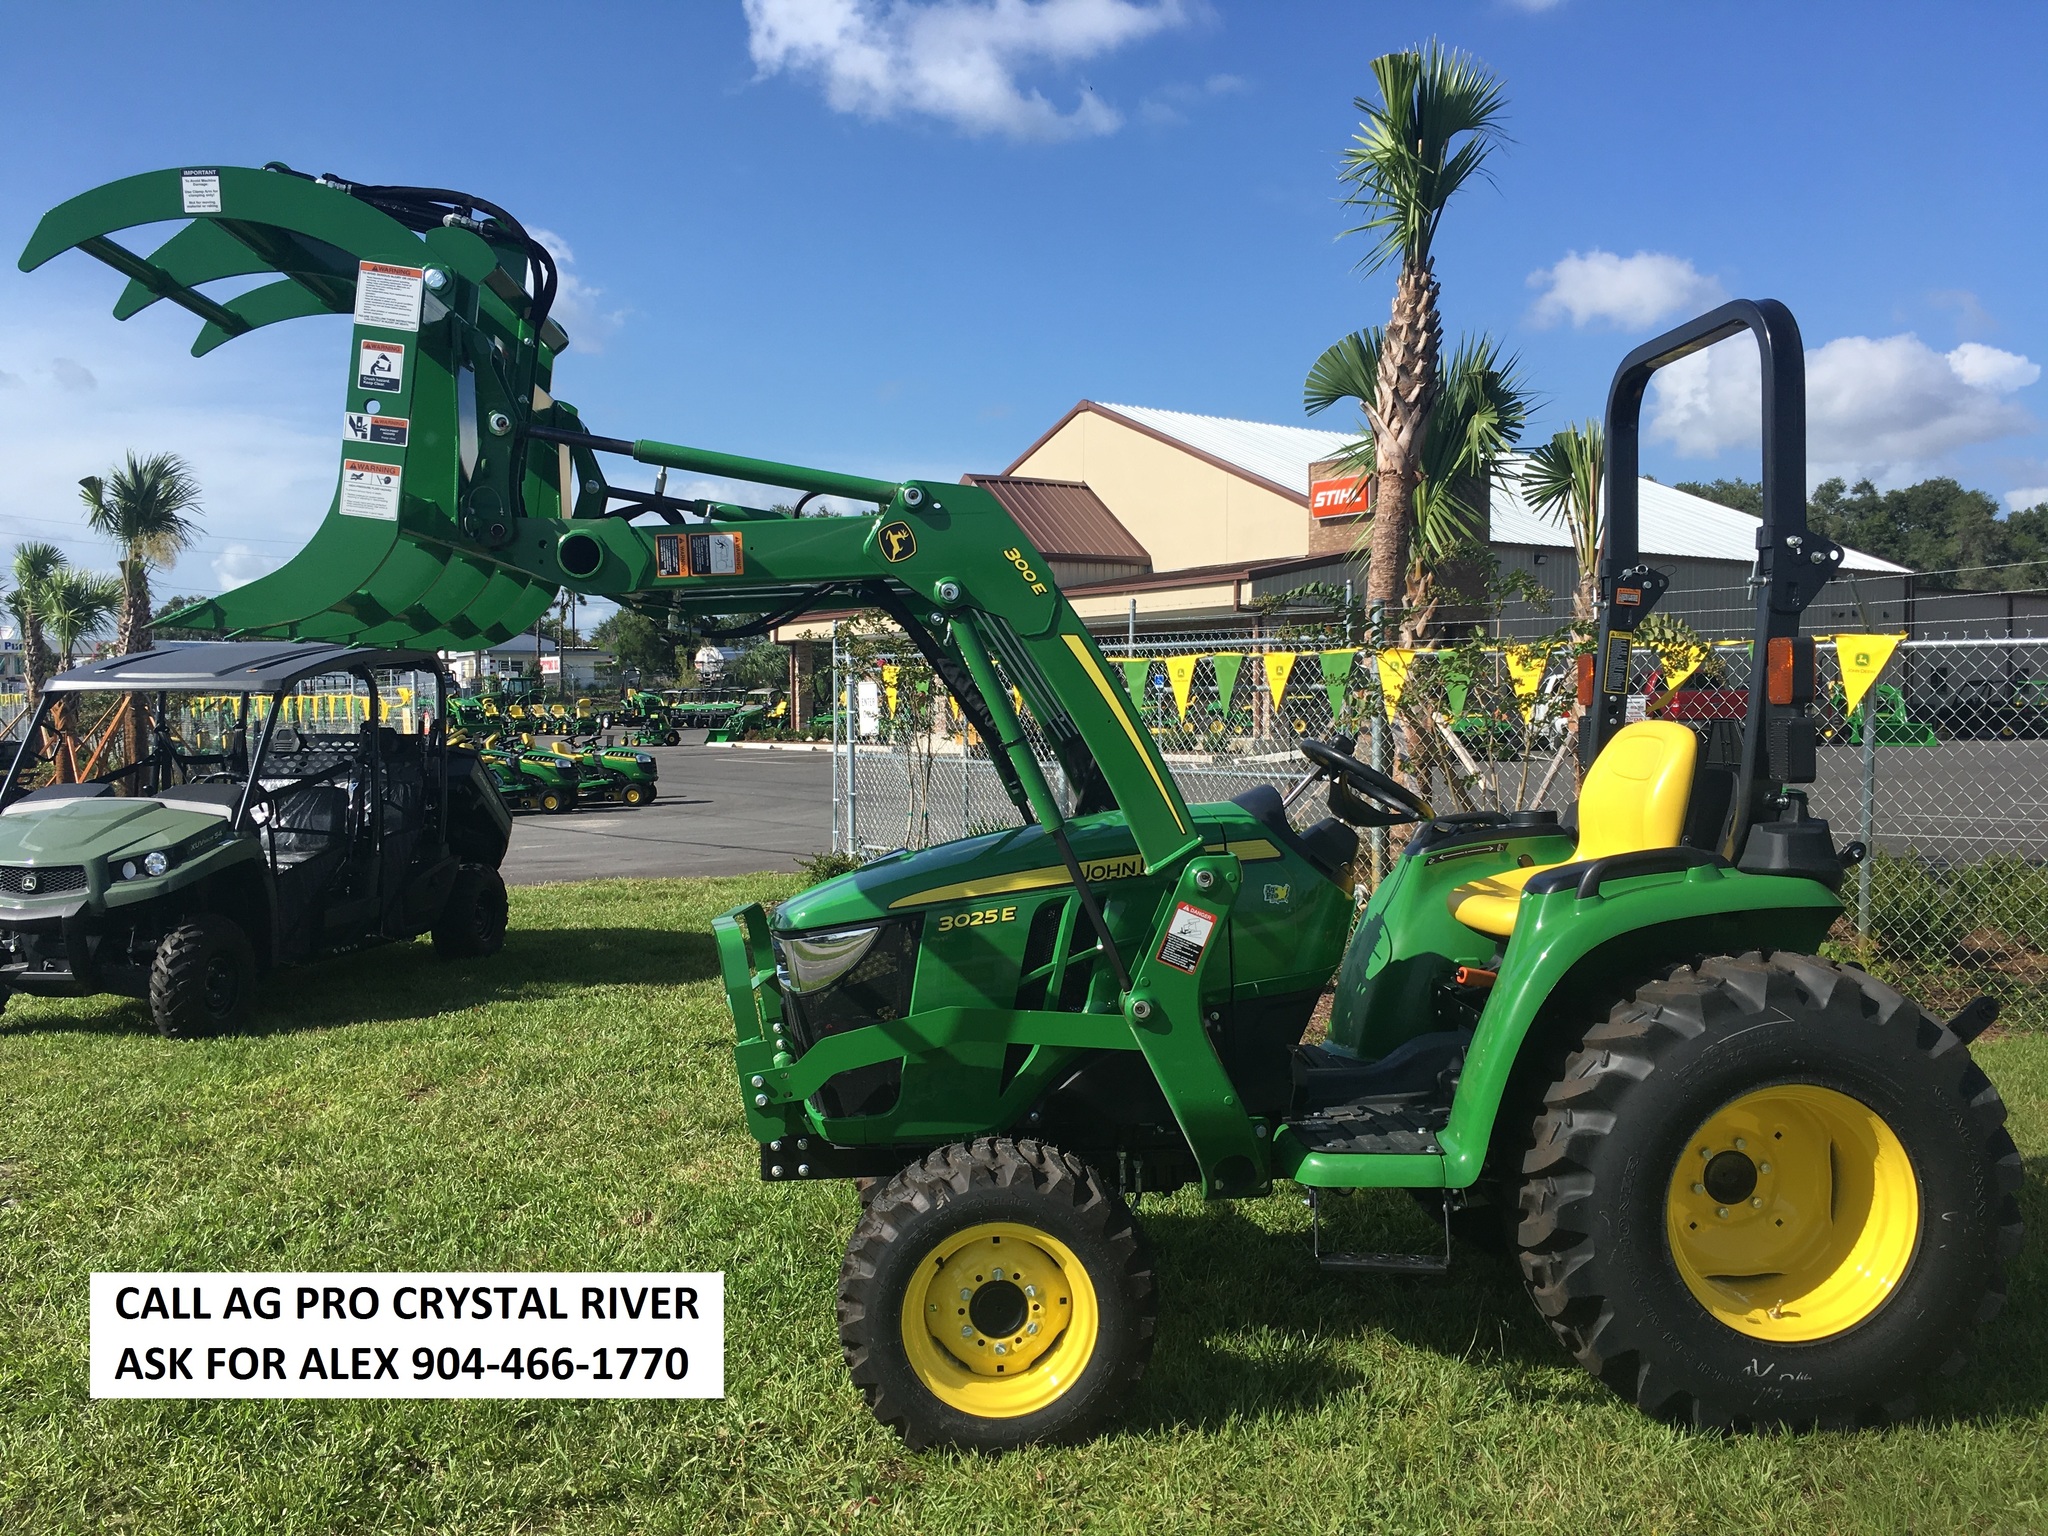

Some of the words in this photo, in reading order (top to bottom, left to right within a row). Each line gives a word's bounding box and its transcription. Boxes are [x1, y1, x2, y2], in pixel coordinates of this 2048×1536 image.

[379, 266, 411, 276] WARNING
[357, 463, 396, 475] WARNING
[1313, 488, 1362, 508] STIHL
[1084, 861, 1136, 882] JOHN
[1190, 907, 1212, 921] DANGER
